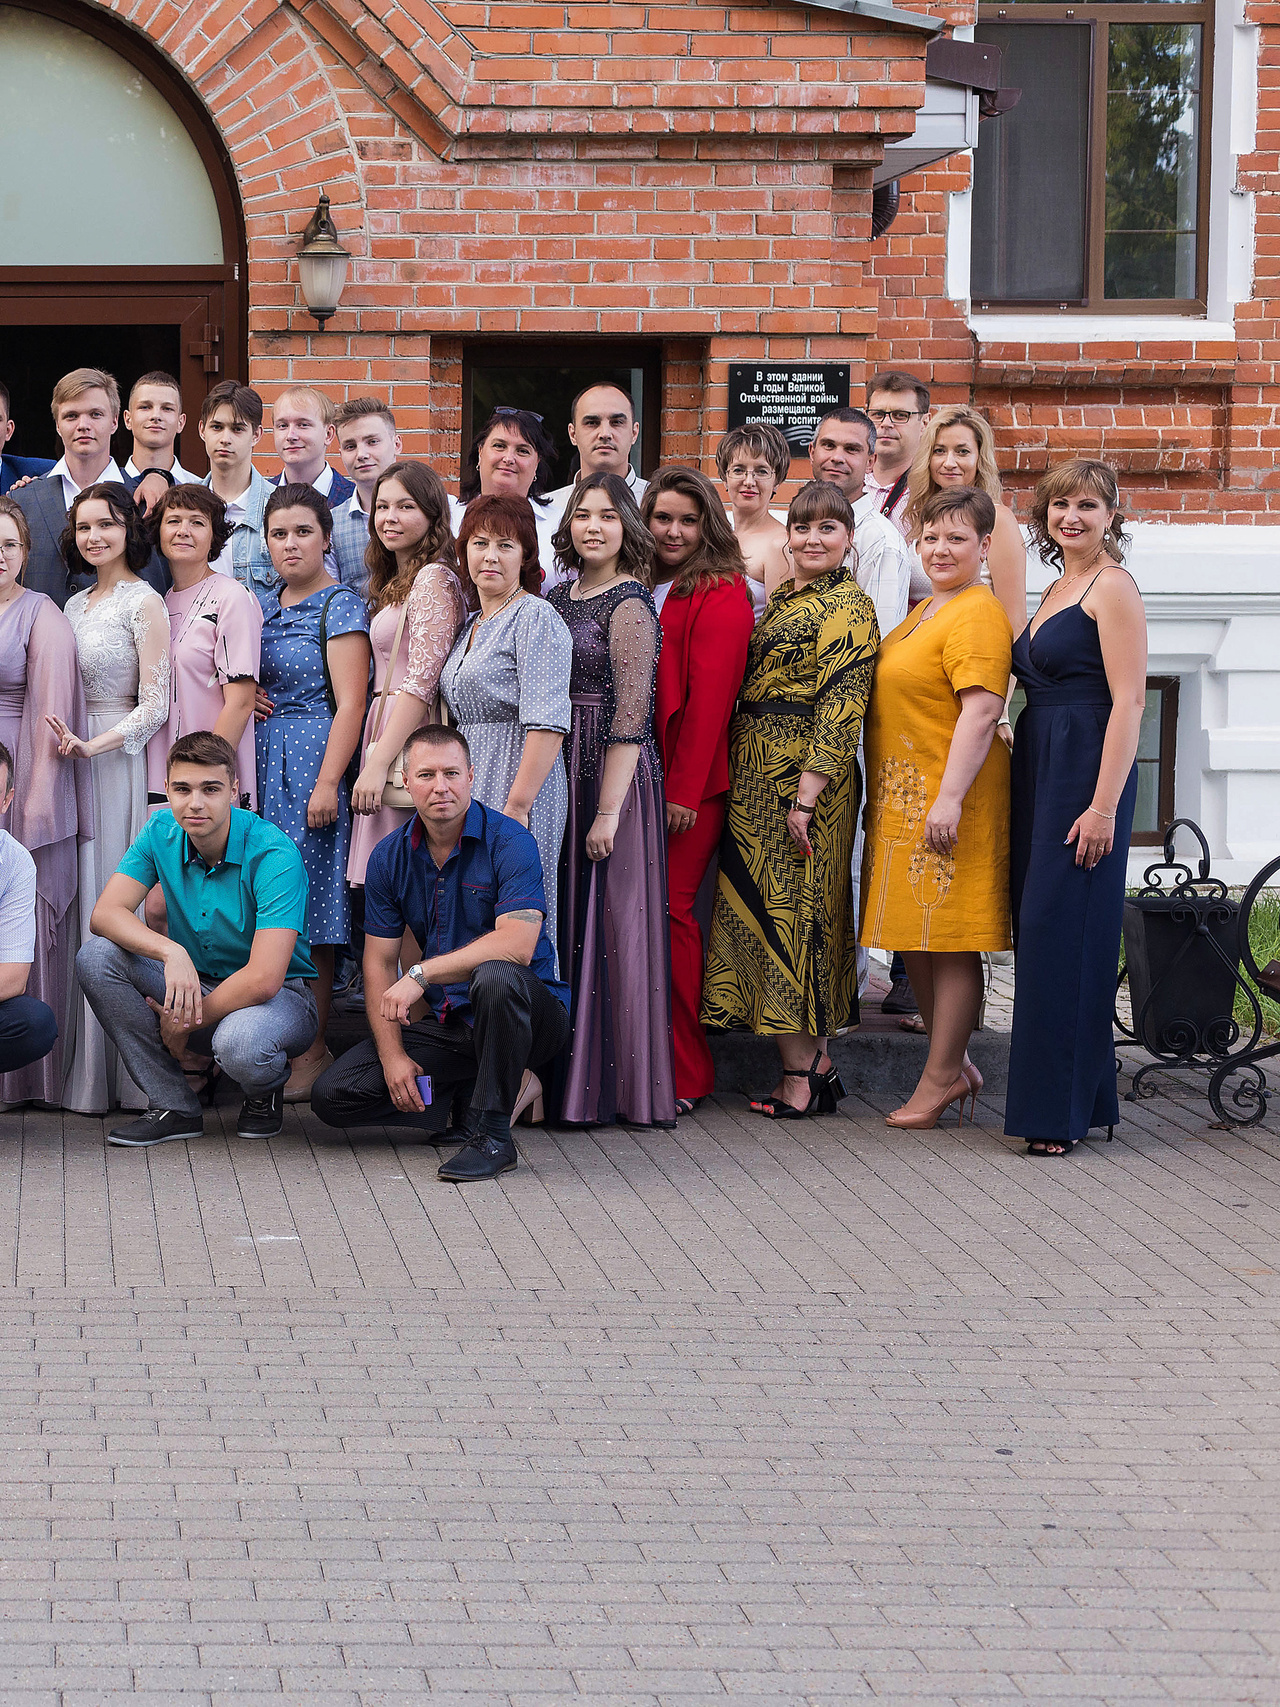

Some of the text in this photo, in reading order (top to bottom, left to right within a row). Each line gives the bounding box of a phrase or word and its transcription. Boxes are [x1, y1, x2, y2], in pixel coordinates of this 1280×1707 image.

[756, 371, 823, 383] В этом здании
[753, 381, 825, 393] в годы Великой
[740, 392, 838, 403] Отечественной войны
[762, 405, 816, 416] размещался
[745, 415, 822, 425] военный госпита
